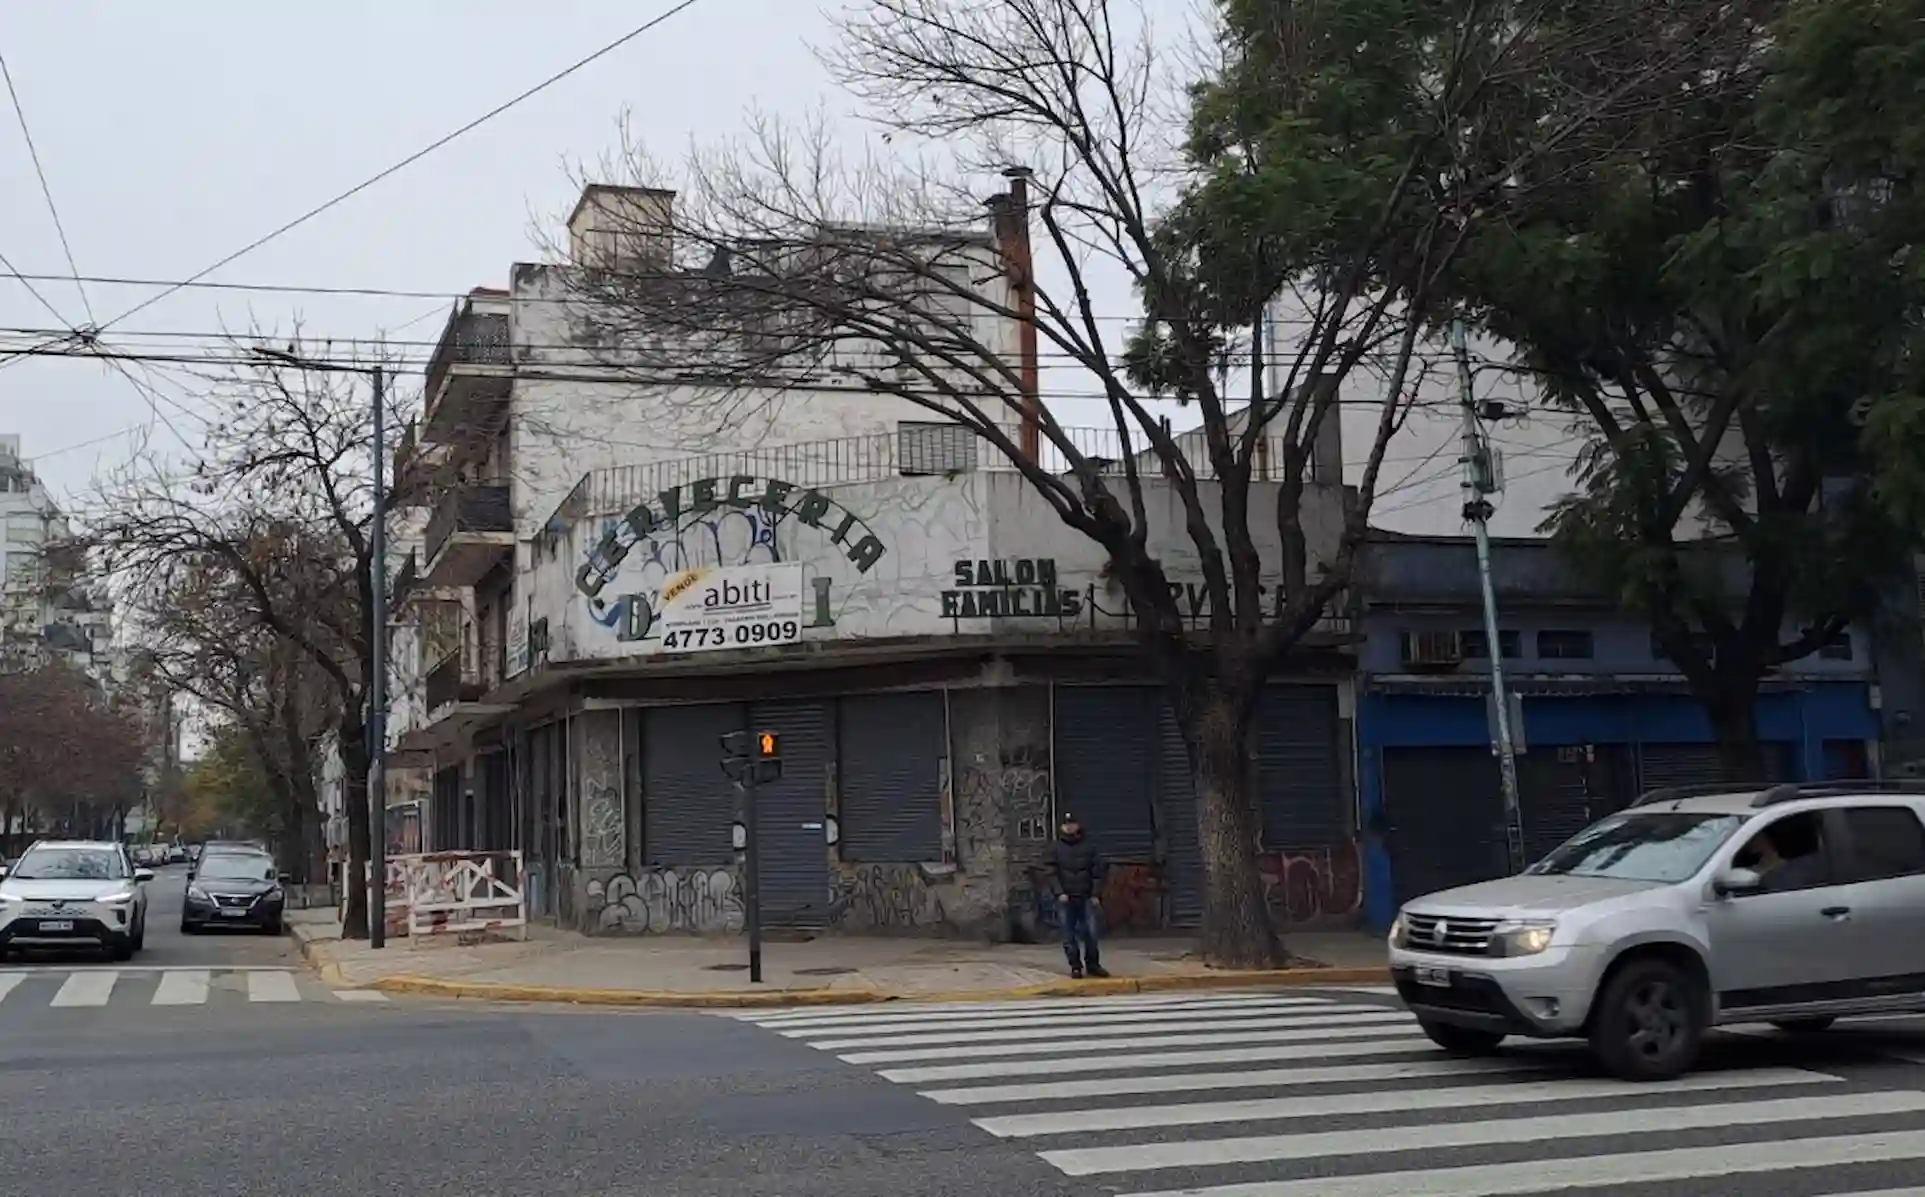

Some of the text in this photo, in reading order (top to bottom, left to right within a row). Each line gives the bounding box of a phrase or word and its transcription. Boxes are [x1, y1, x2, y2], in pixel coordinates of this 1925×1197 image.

[575, 475, 887, 598] CERVECERIA
[955, 559, 1057, 586] SALON
[704, 575, 771, 607] abiti
[663, 621, 798, 649] 4773 0909
